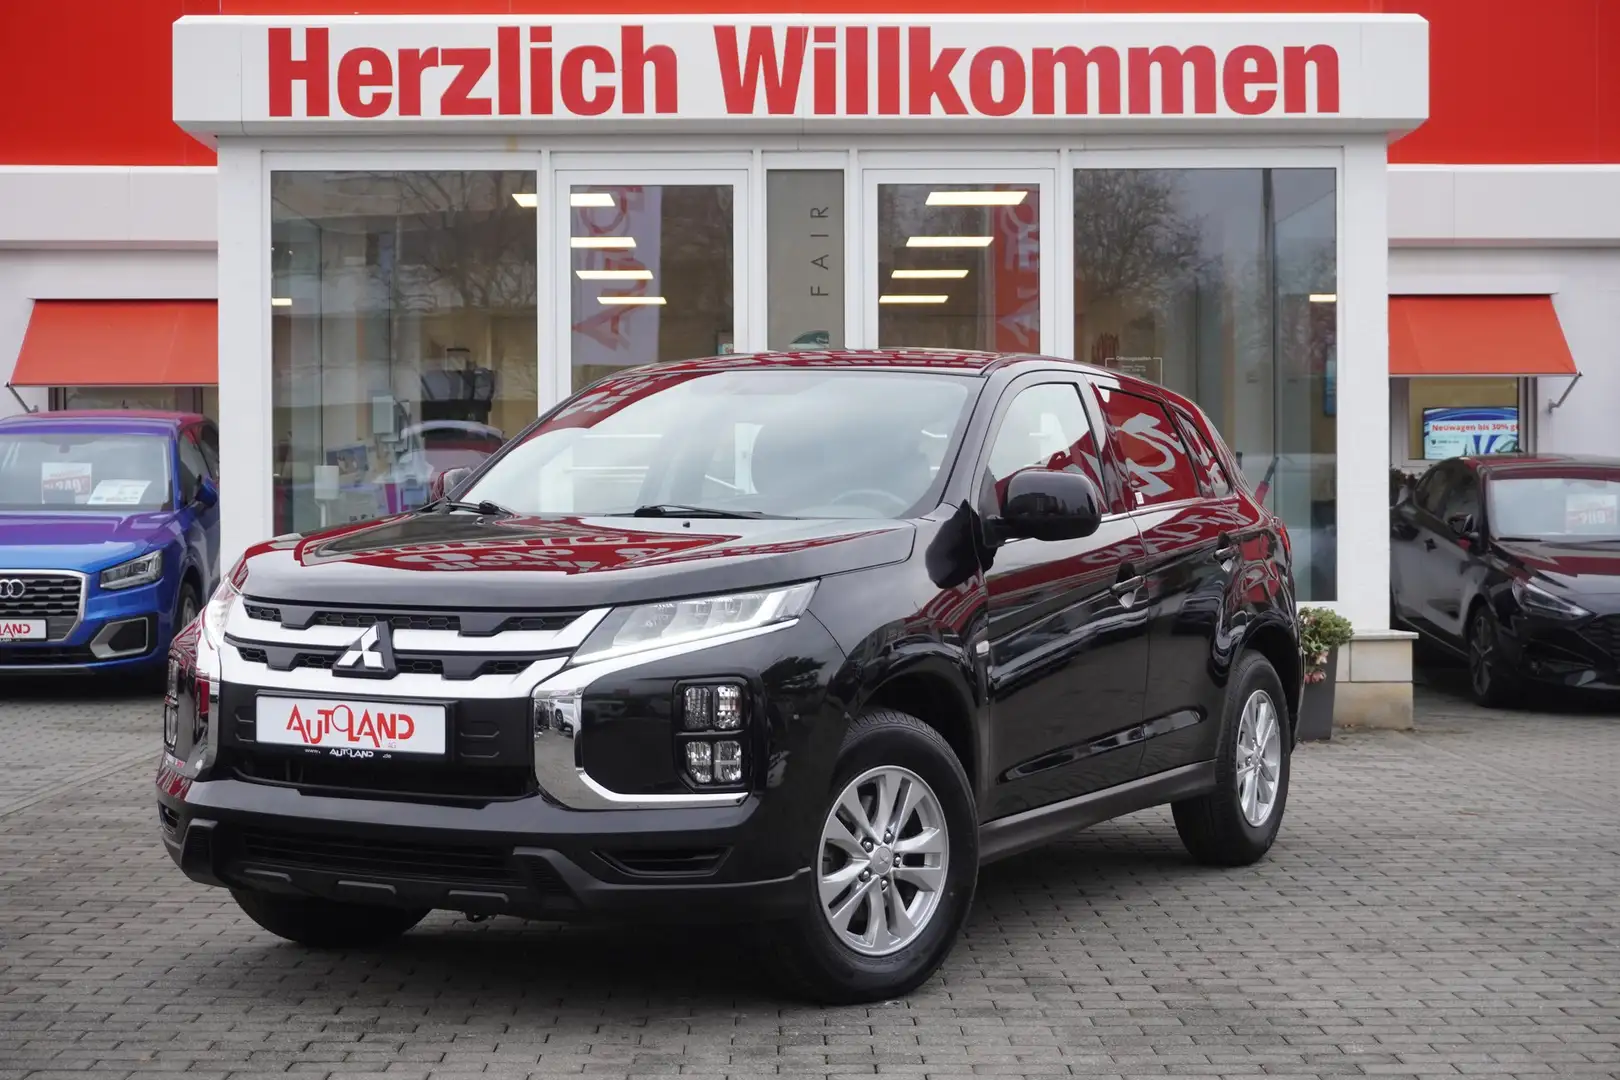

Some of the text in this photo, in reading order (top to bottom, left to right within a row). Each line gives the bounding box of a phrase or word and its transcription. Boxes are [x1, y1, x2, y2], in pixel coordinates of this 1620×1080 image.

[267, 25, 1340, 118] Herzlich Willkommen
[810, 206, 829, 297] FAIR
[1432, 423, 1476, 433] Neuwagen
[1477, 423, 1490, 431] bis
